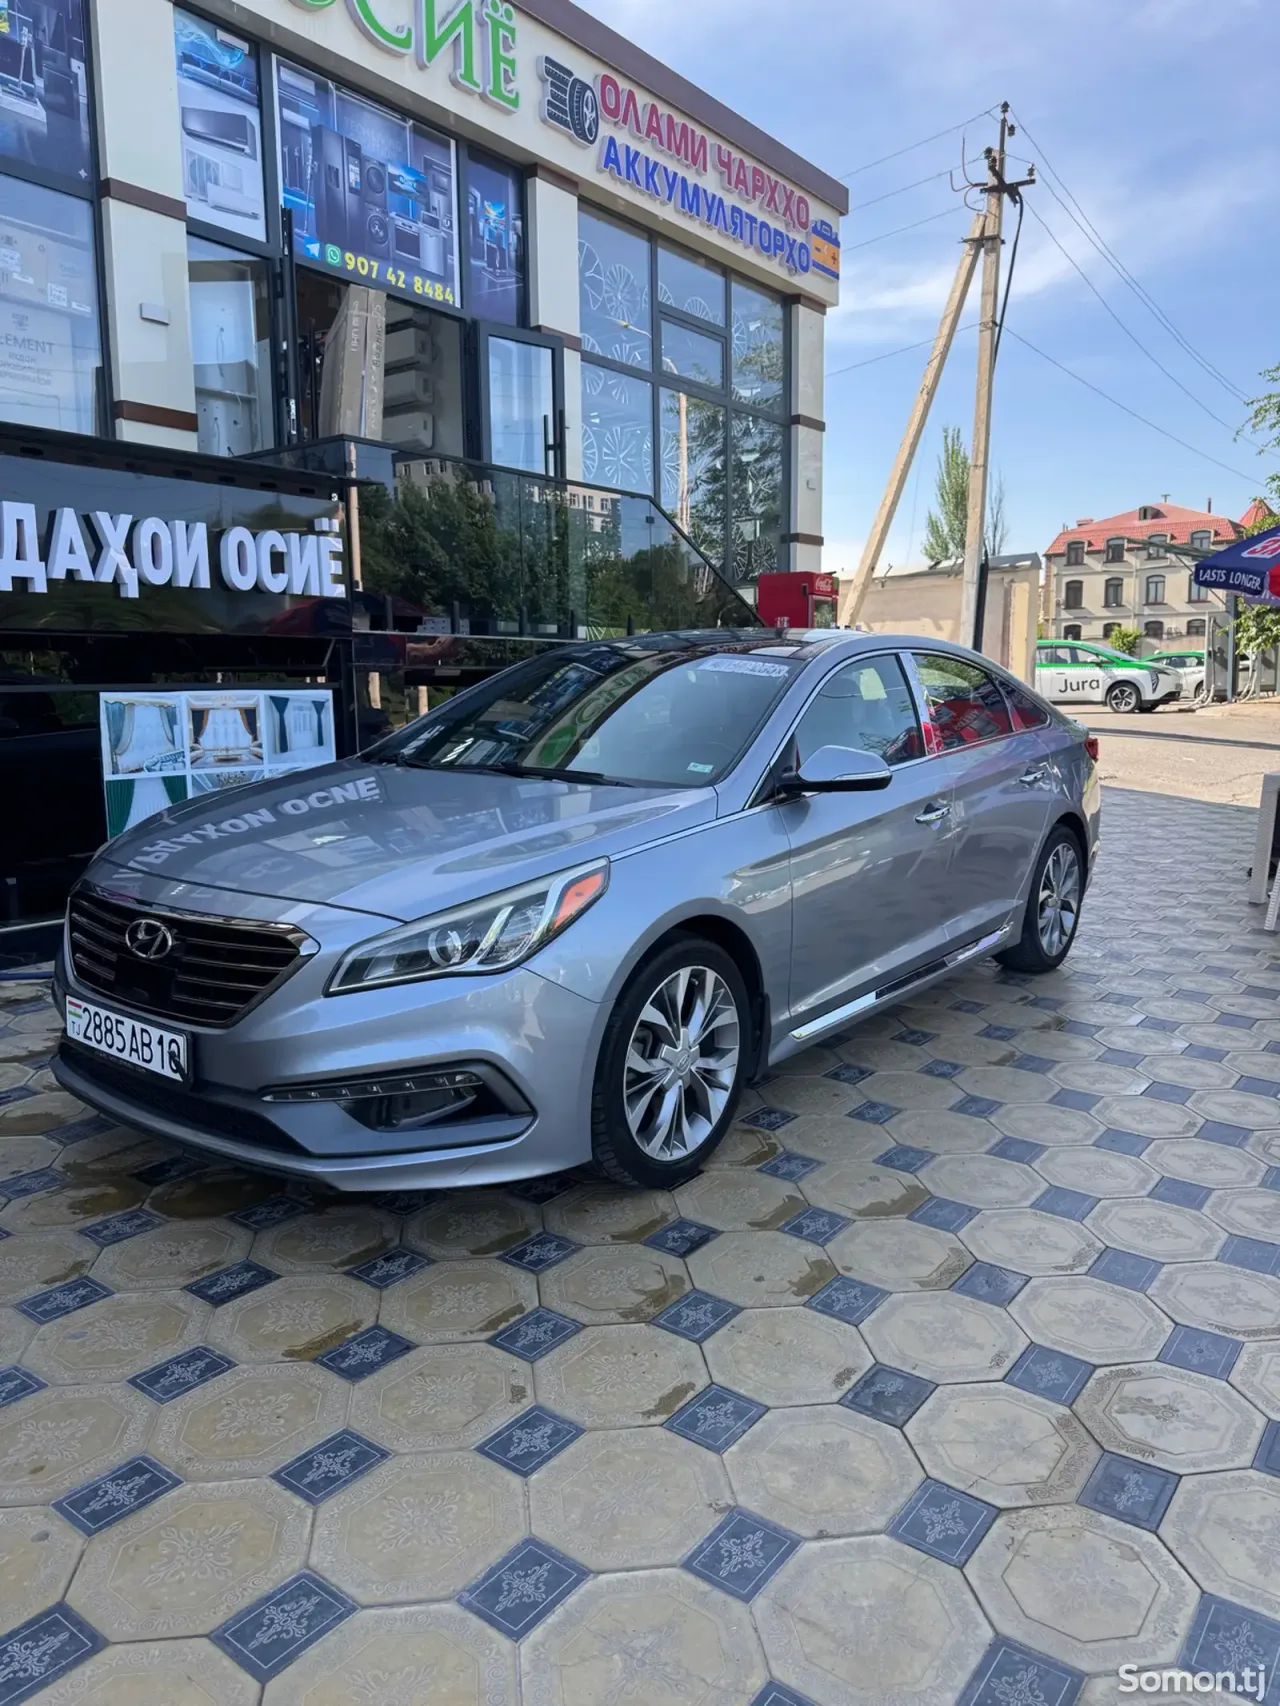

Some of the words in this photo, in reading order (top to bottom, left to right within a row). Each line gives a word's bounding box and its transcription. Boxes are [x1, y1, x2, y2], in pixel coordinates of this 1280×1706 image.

[598, 73, 708, 176] ОЛАМИ
[344, 252, 379, 279] 907
[386, 267, 406, 289] 42
[413, 276, 454, 305] 8484
[0, 500, 210, 599] ДАҲОИ
[220, 516, 346, 599] ОСИЁ
[1199, 569, 1227, 582] LASTS
[1229, 572, 1262, 591] LONGER
[1058, 678, 1100, 693] Jura
[71, 1021, 81, 1036] TJ
